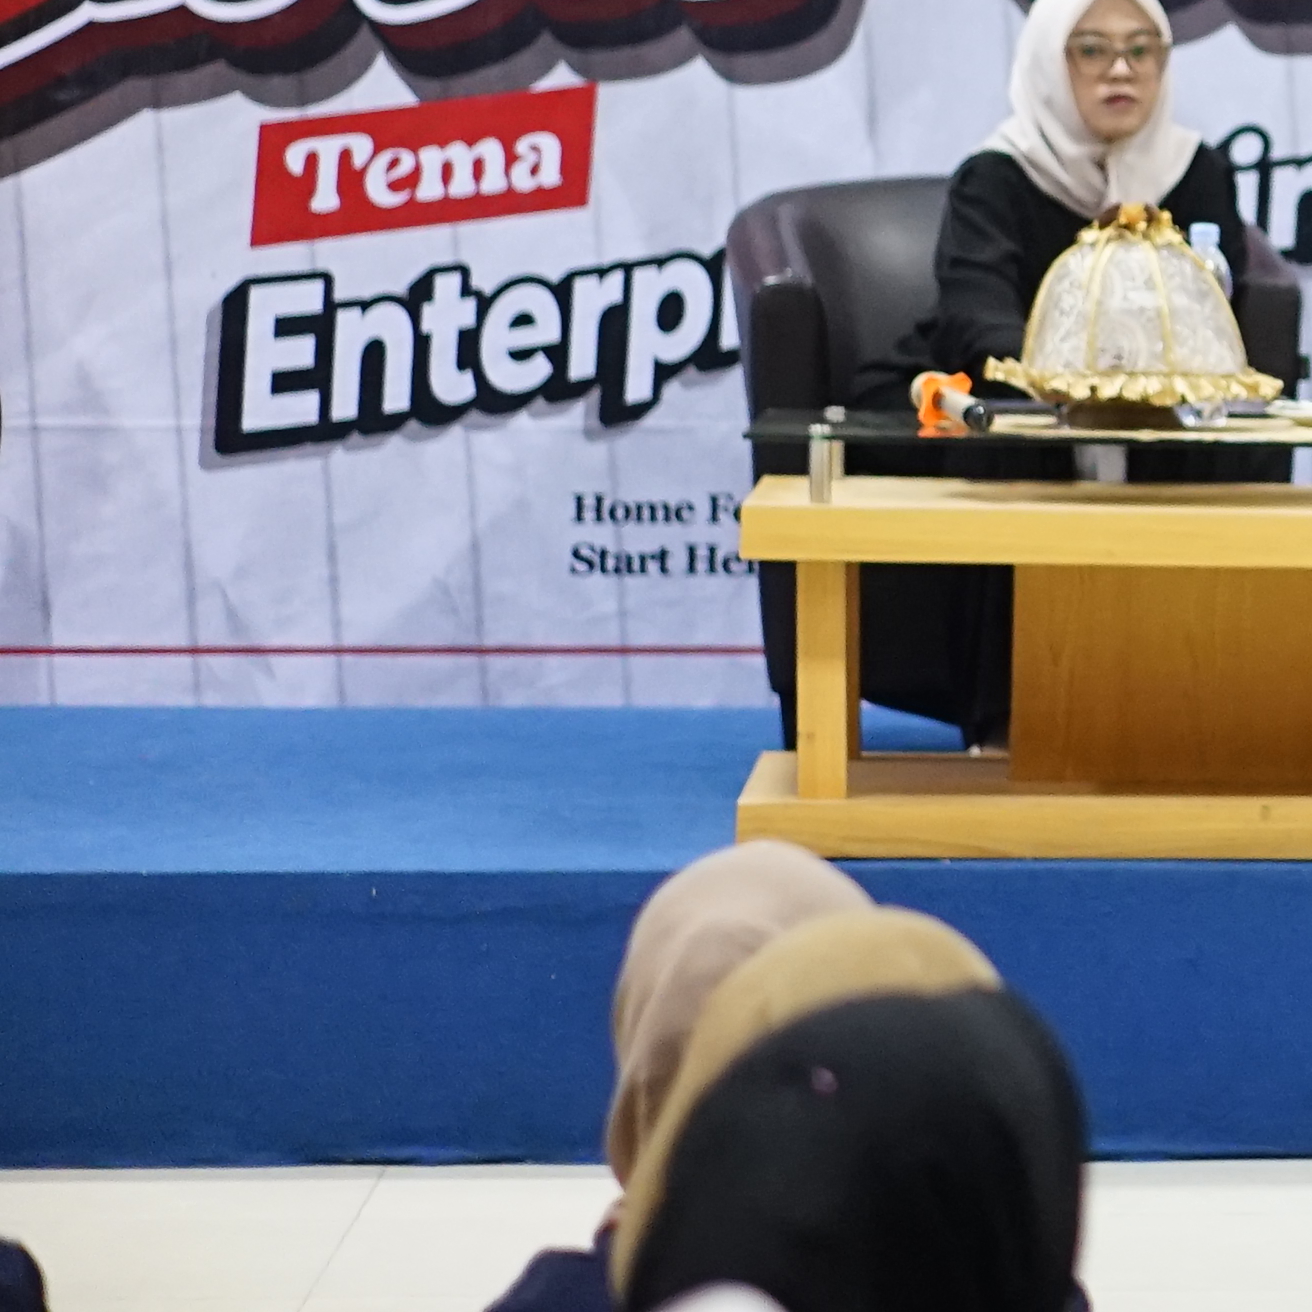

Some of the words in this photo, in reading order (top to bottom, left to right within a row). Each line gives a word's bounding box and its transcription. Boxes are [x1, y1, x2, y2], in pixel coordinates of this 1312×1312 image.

[283, 129, 564, 215] Tema
[571, 491, 696, 525] Home
[569, 541, 672, 576] Start
